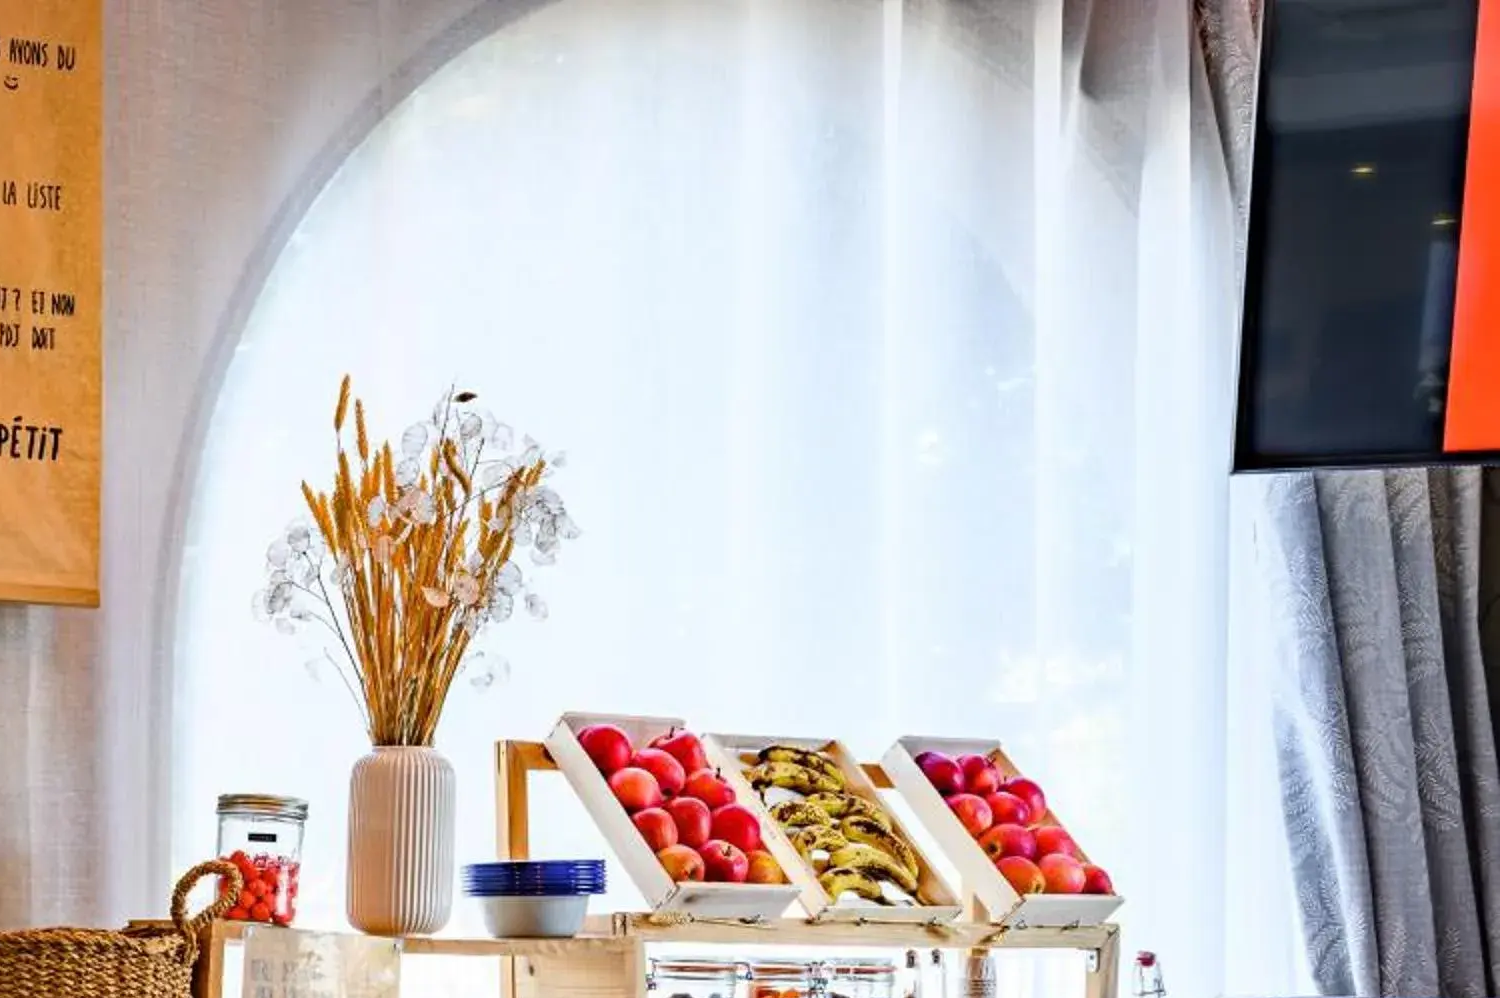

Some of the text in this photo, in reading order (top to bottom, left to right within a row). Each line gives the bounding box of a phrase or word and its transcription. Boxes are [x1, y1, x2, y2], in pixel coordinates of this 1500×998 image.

[9, 37, 49, 67] AVONS
[56, 45, 76, 71] DU
[2, 181, 18, 206] LA
[31, 290, 45, 315] ET
[51, 293, 76, 316] NON
